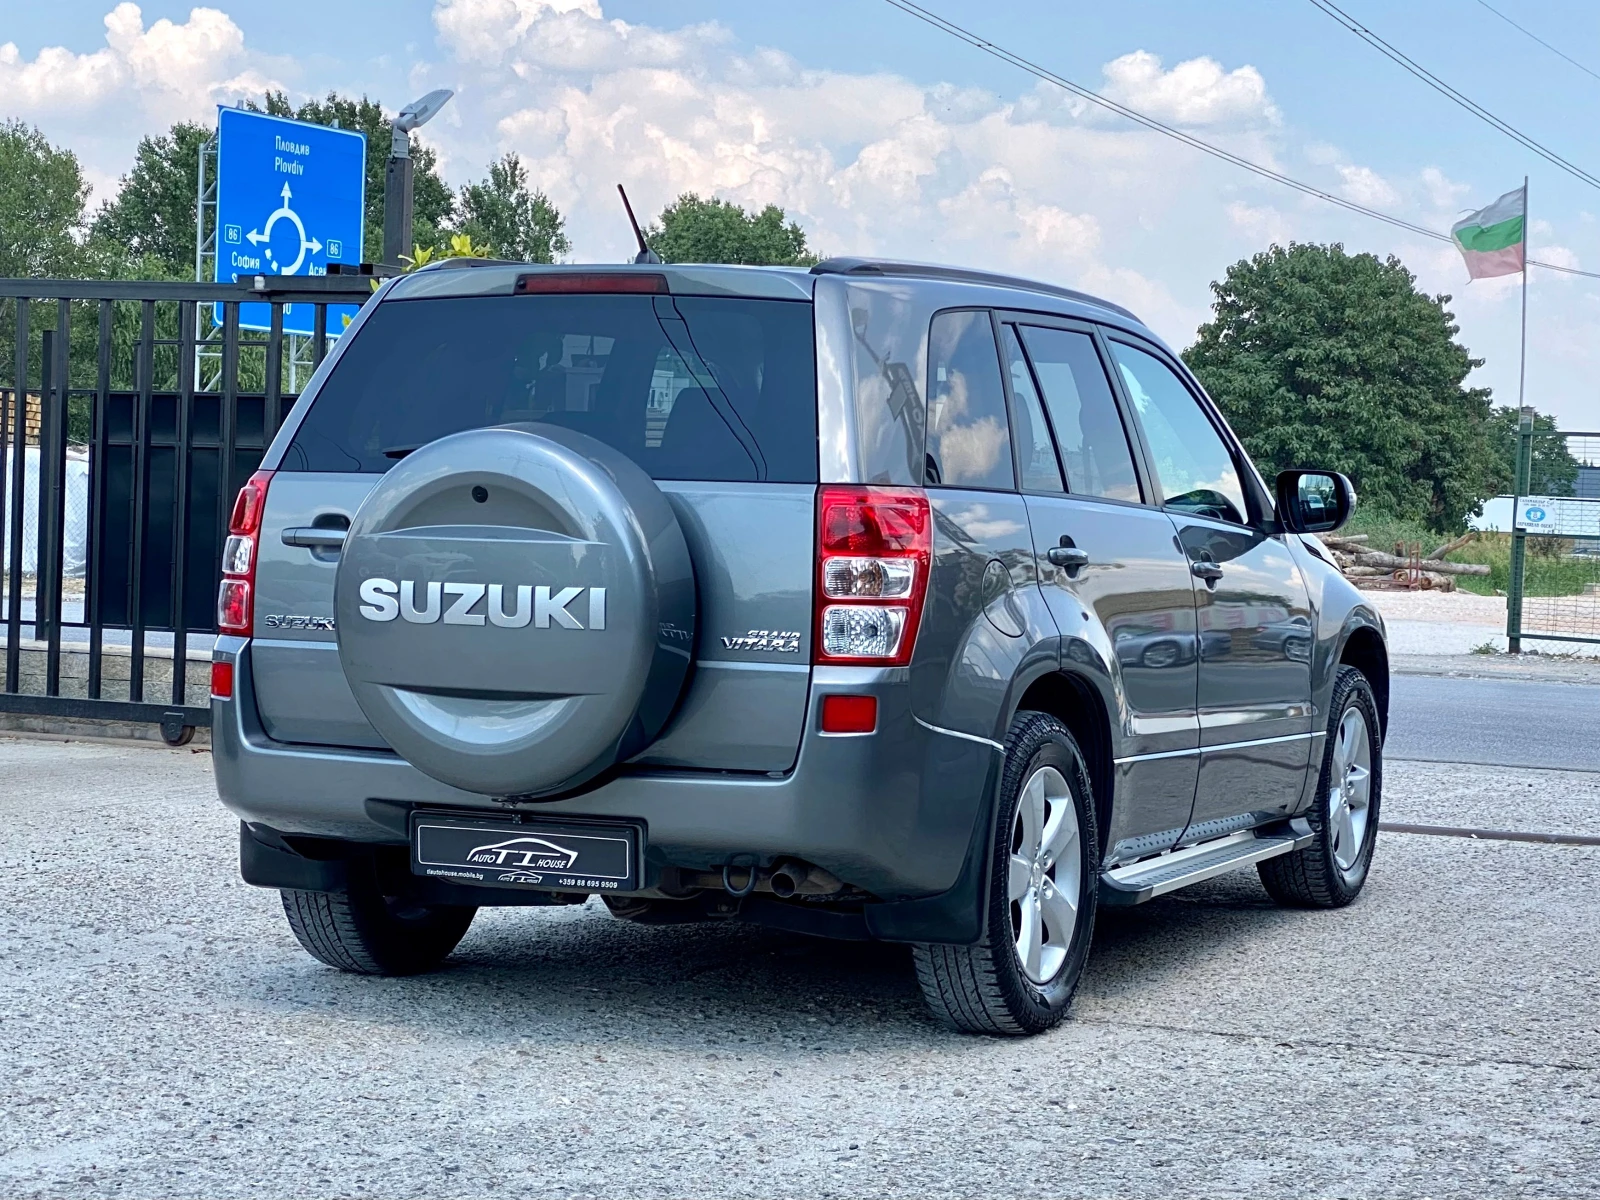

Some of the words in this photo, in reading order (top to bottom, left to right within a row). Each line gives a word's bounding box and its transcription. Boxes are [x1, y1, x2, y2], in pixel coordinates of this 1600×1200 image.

[275, 135, 310, 156] Пловдив
[274, 156, 304, 176] Plovdiv
[228, 228, 238, 241] 86
[329, 243, 339, 255] 86
[231, 251, 260, 270] София
[359, 577, 607, 631] SUZUKI
[264, 614, 335, 631] SUZUK
[747, 629, 801, 641] GRAND
[720, 636, 800, 654] VITARA
[471, 854, 496, 864] AUTO
[536, 858, 567, 869] HOUSE
[558, 878, 576, 886] +359
[600, 881, 618, 889] 9509
